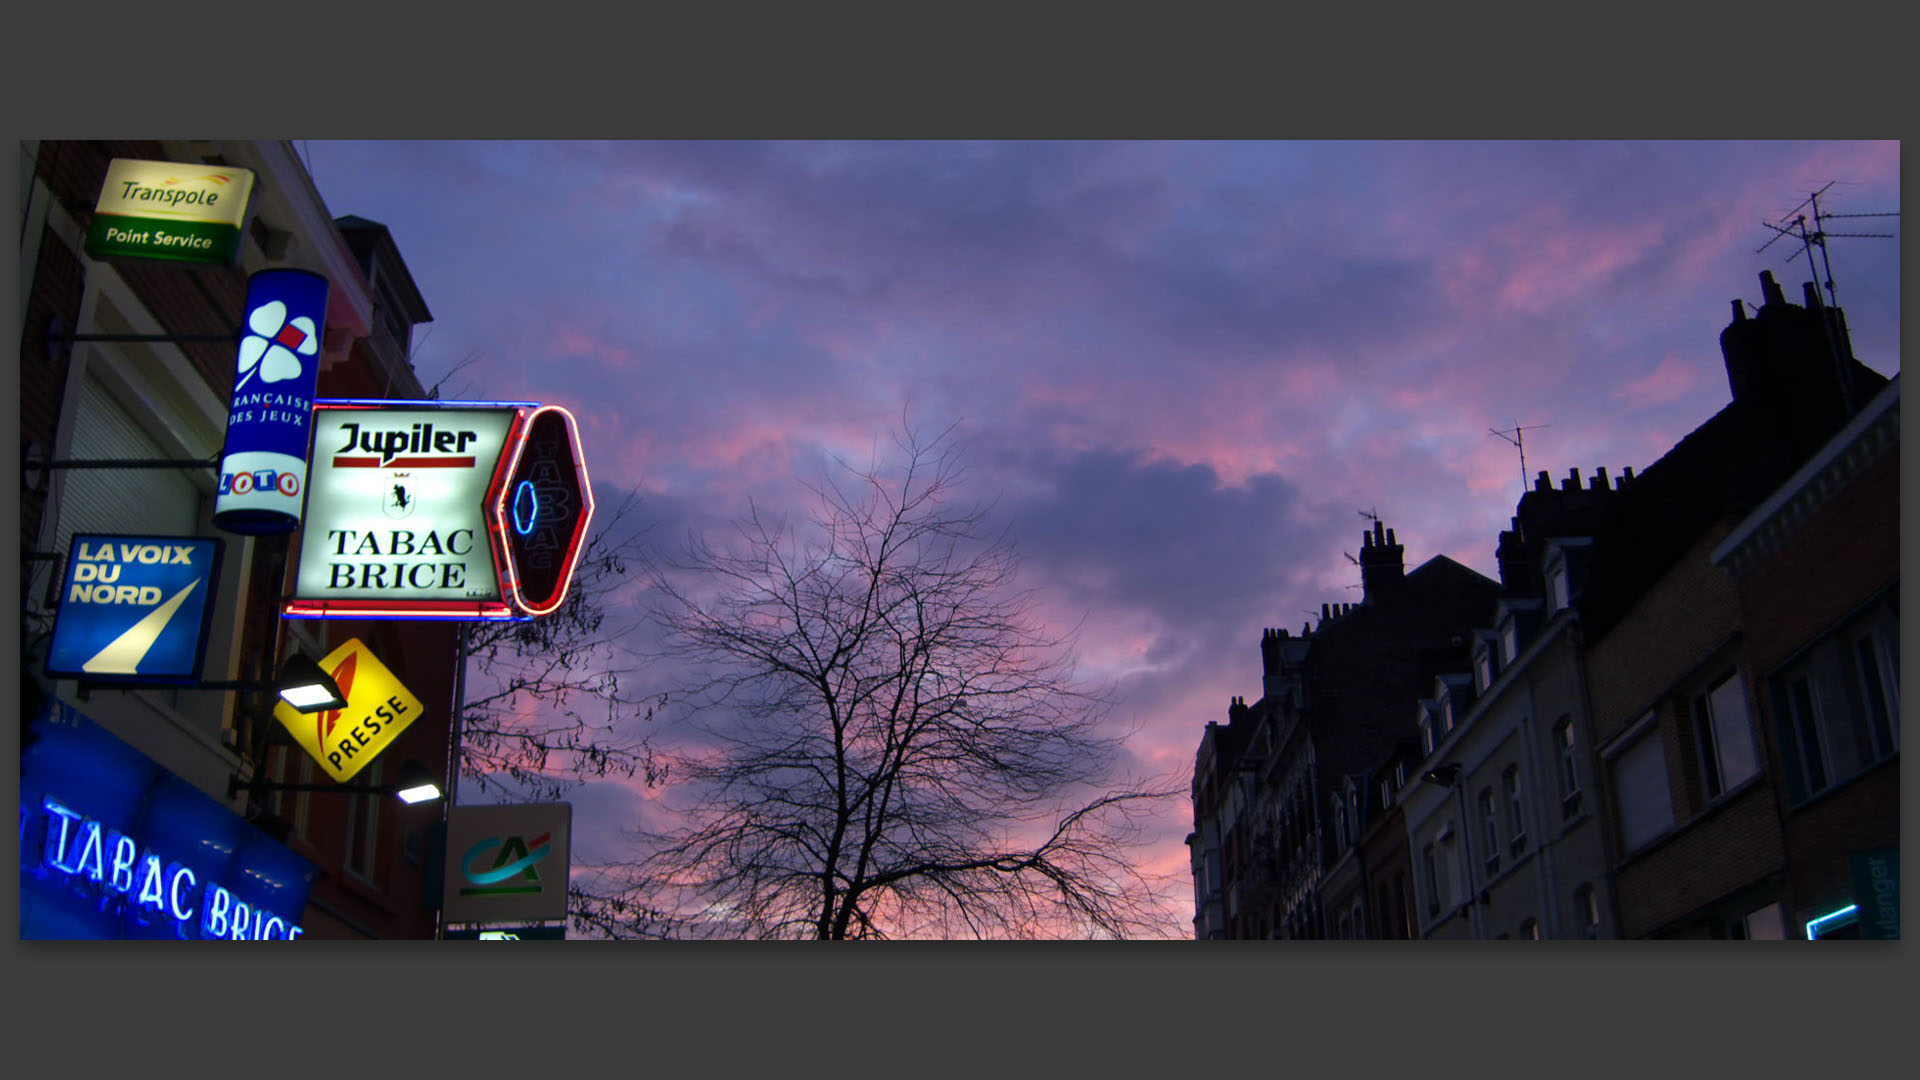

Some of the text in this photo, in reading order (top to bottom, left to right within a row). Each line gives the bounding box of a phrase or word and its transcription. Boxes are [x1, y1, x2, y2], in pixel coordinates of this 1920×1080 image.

[121, 181, 219, 207] Transpole
[105, 227, 212, 250] Point Service
[229, 410, 303, 427] DES JEUX
[337, 424, 476, 464] Jupiler
[219, 469, 299, 497] LOTO
[78, 543, 196, 565] LA VOIX
[328, 530, 473, 556] TABAC
[74, 564, 121, 583] DU
[326, 563, 467, 590] BRICE
[69, 584, 162, 605] NORD
[327, 696, 408, 771] PRESSE
[44, 796, 196, 920] TABAC
[207, 883, 303, 940] BRIC
